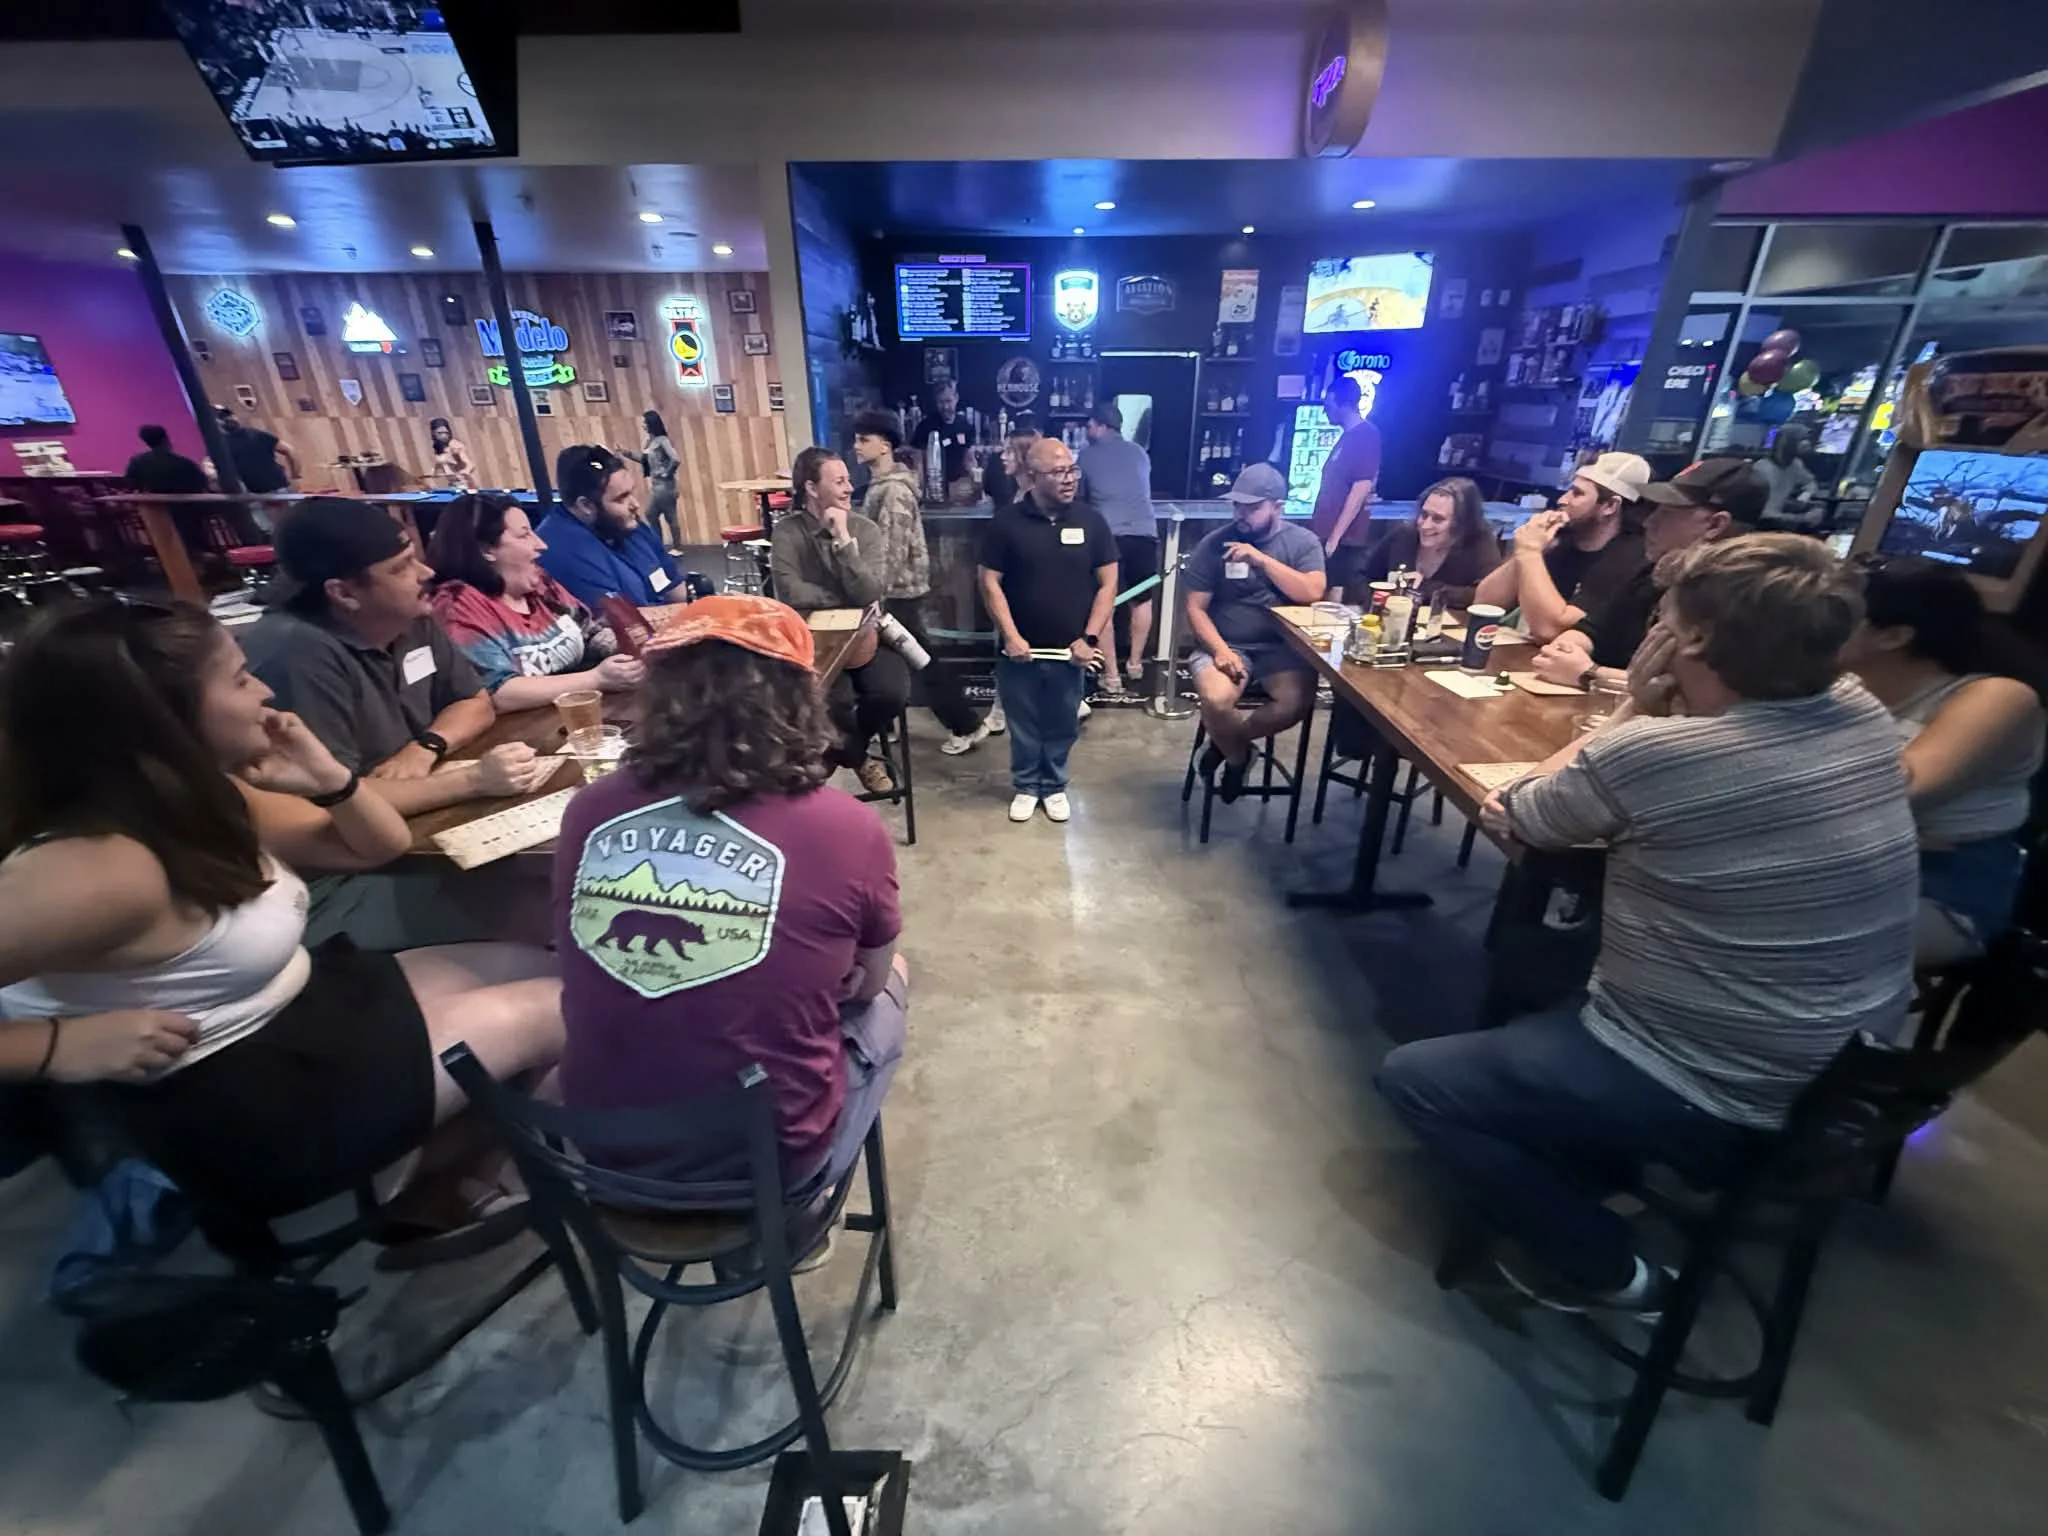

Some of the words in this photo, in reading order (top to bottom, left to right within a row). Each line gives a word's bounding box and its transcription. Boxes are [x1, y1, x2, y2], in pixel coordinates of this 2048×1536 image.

[474, 318, 568, 356] Mdelo
[1337, 350, 1391, 371] Corona
[596, 826, 769, 882] VOYAGER
[717, 927, 752, 942] USA
